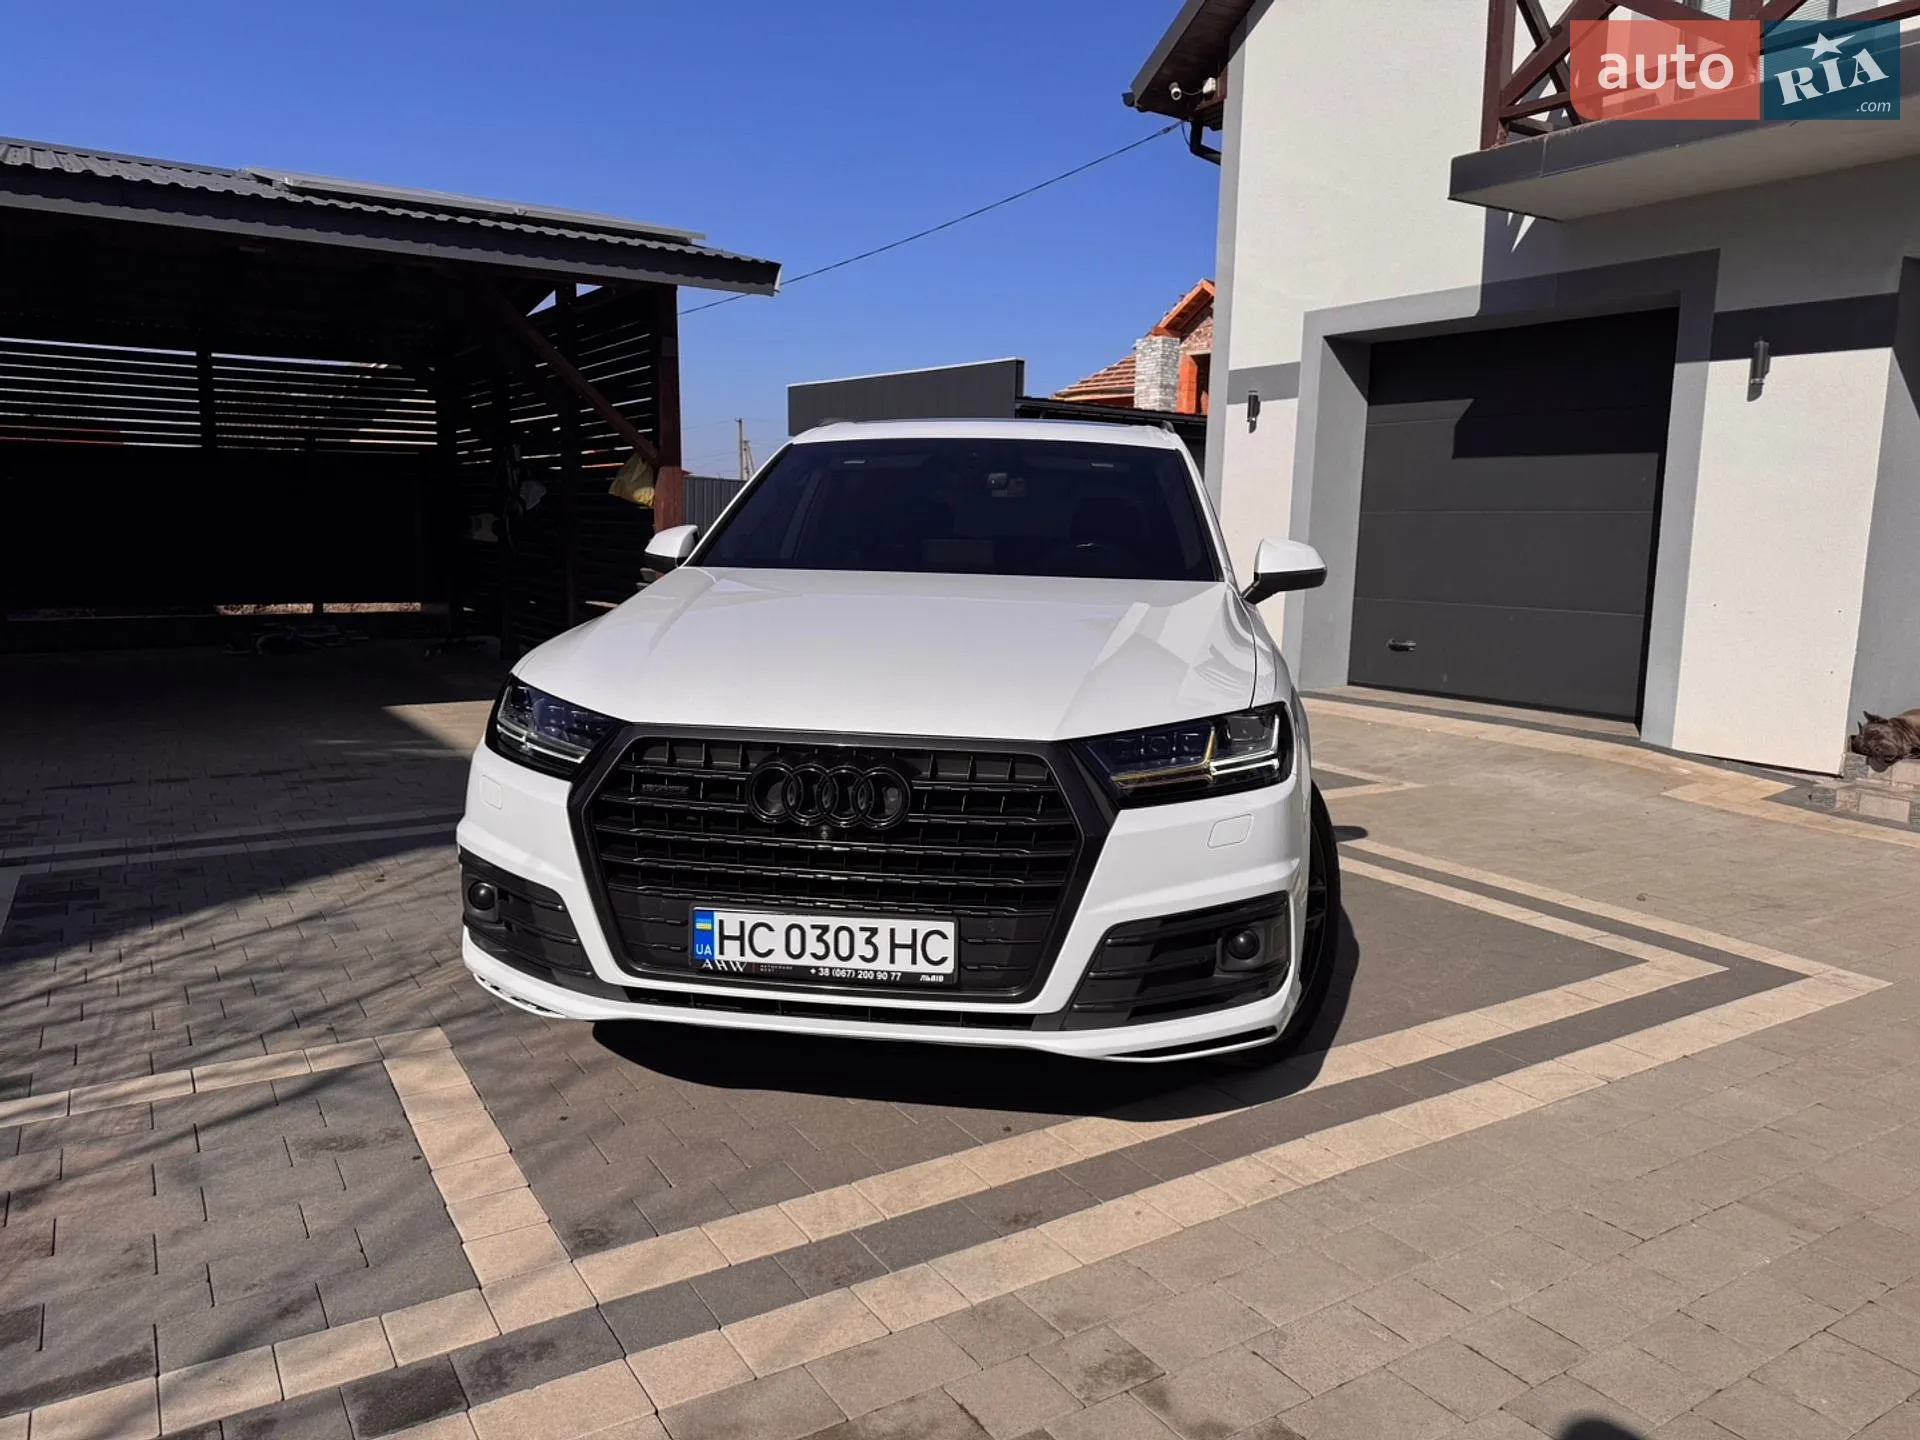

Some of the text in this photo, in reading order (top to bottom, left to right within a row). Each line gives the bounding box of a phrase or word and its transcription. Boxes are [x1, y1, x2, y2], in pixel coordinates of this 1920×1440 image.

[718, 918, 949, 966] HC 0303 HC
[695, 943, 712, 956] UA
[857, 970, 874, 980] 200
[890, 972, 902, 981] 77
